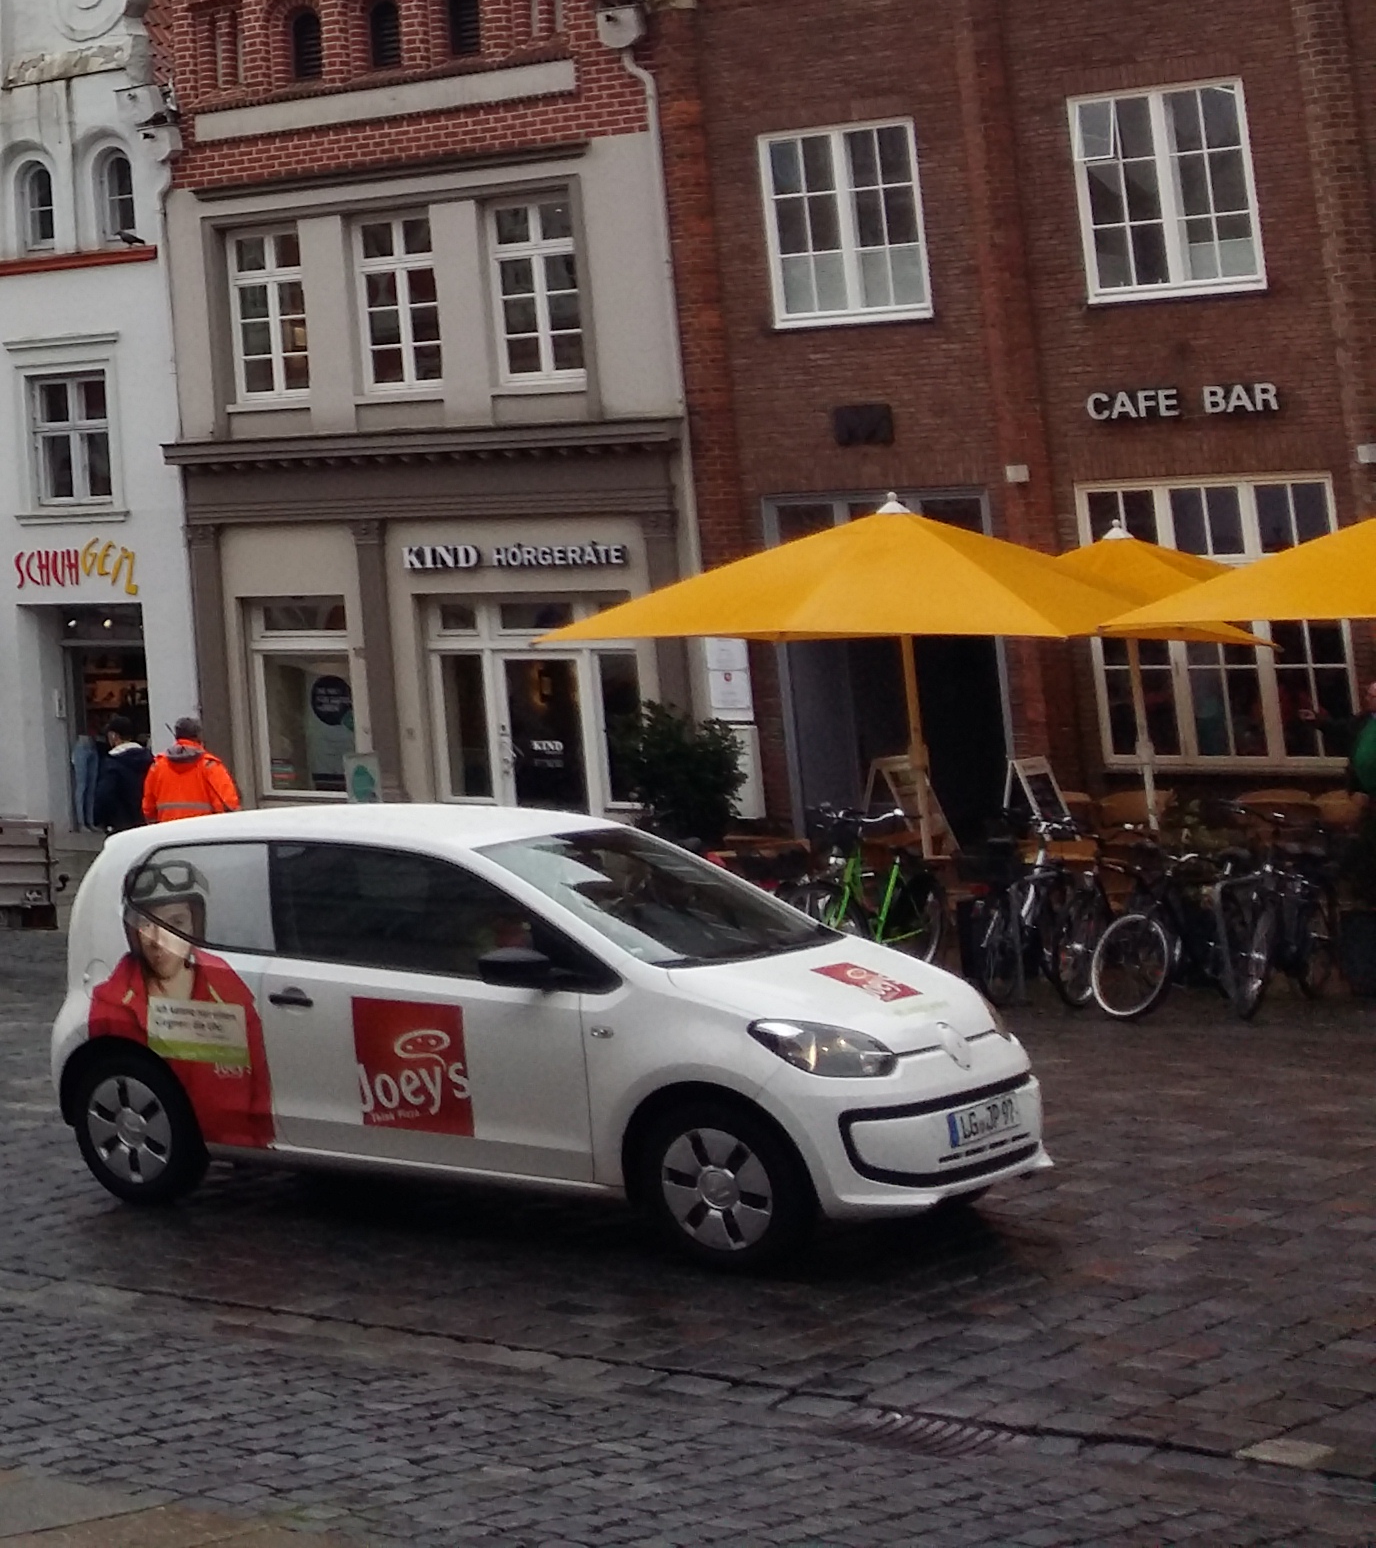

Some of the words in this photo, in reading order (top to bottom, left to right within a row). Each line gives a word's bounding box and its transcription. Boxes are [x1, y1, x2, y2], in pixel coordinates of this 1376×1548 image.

[1086, 388, 1180, 420] CAFE
[1202, 382, 1279, 414] BAR
[402, 545, 480, 569] KIND
[960, 1111, 979, 1139] LG
